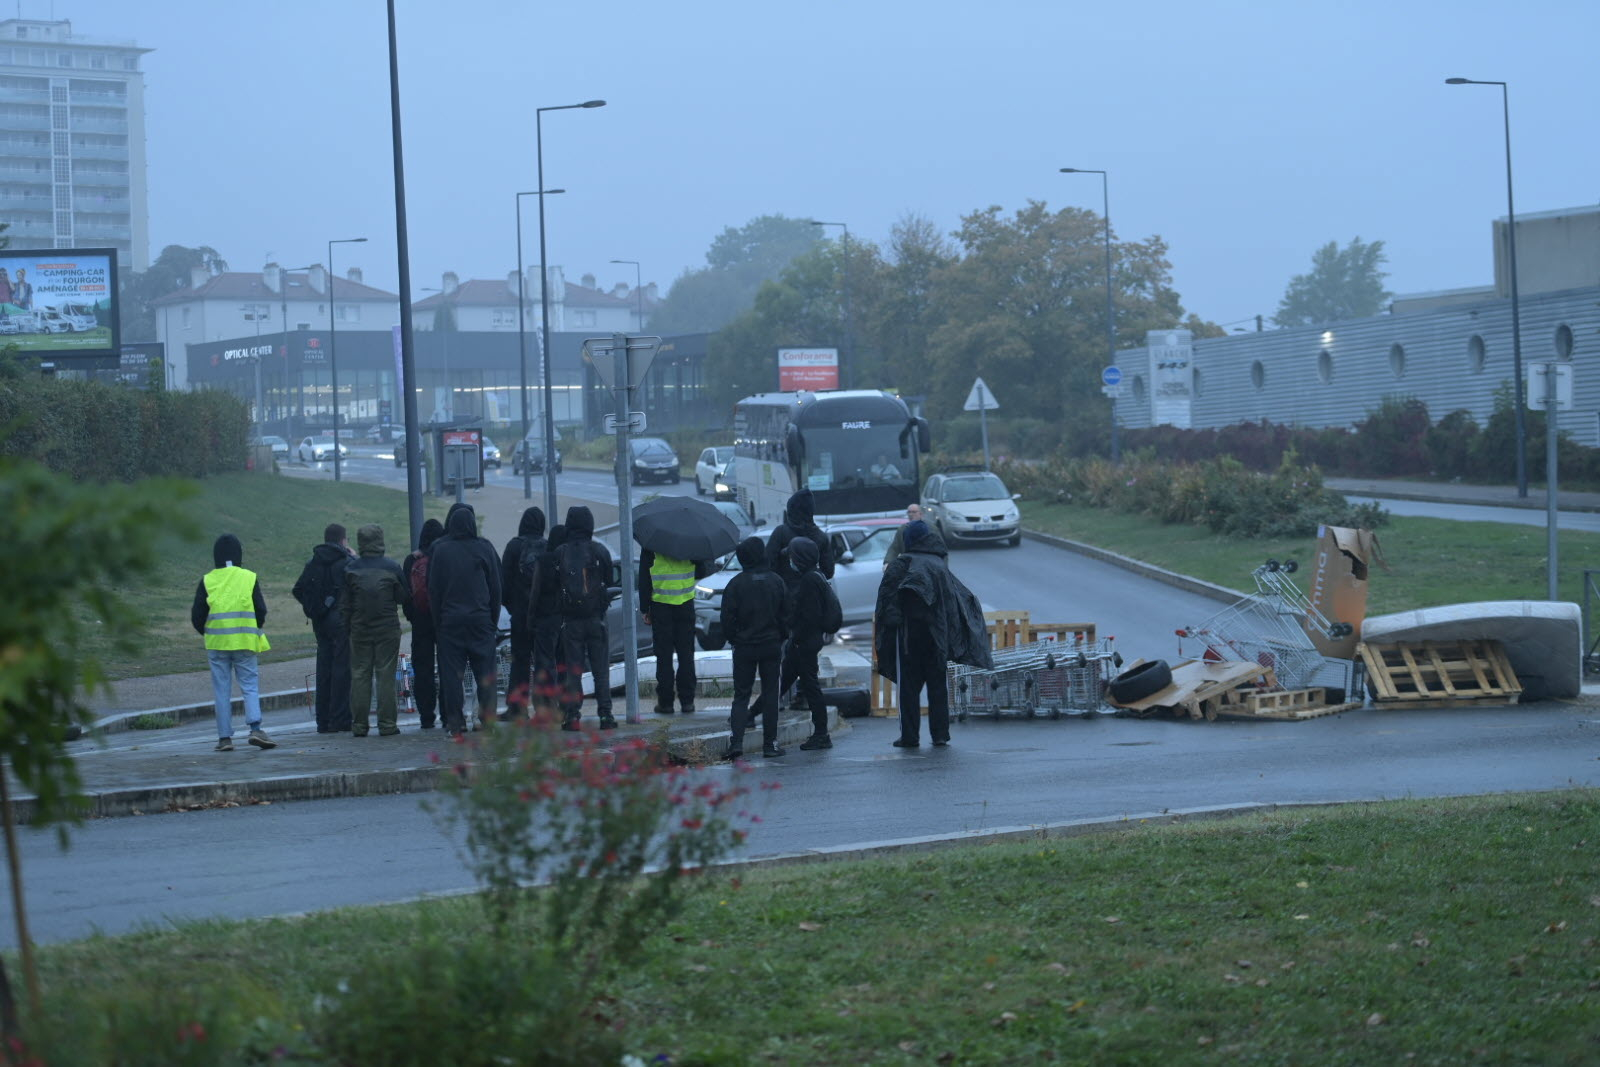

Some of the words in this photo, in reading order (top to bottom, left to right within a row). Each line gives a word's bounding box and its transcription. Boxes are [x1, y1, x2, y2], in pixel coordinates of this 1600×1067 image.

[43, 269, 105, 277] CAMPING-CAR
[224, 348, 250, 360] OPTICAL
[783, 352, 833, 361] Conforama
[842, 421, 871, 430] FAURE
